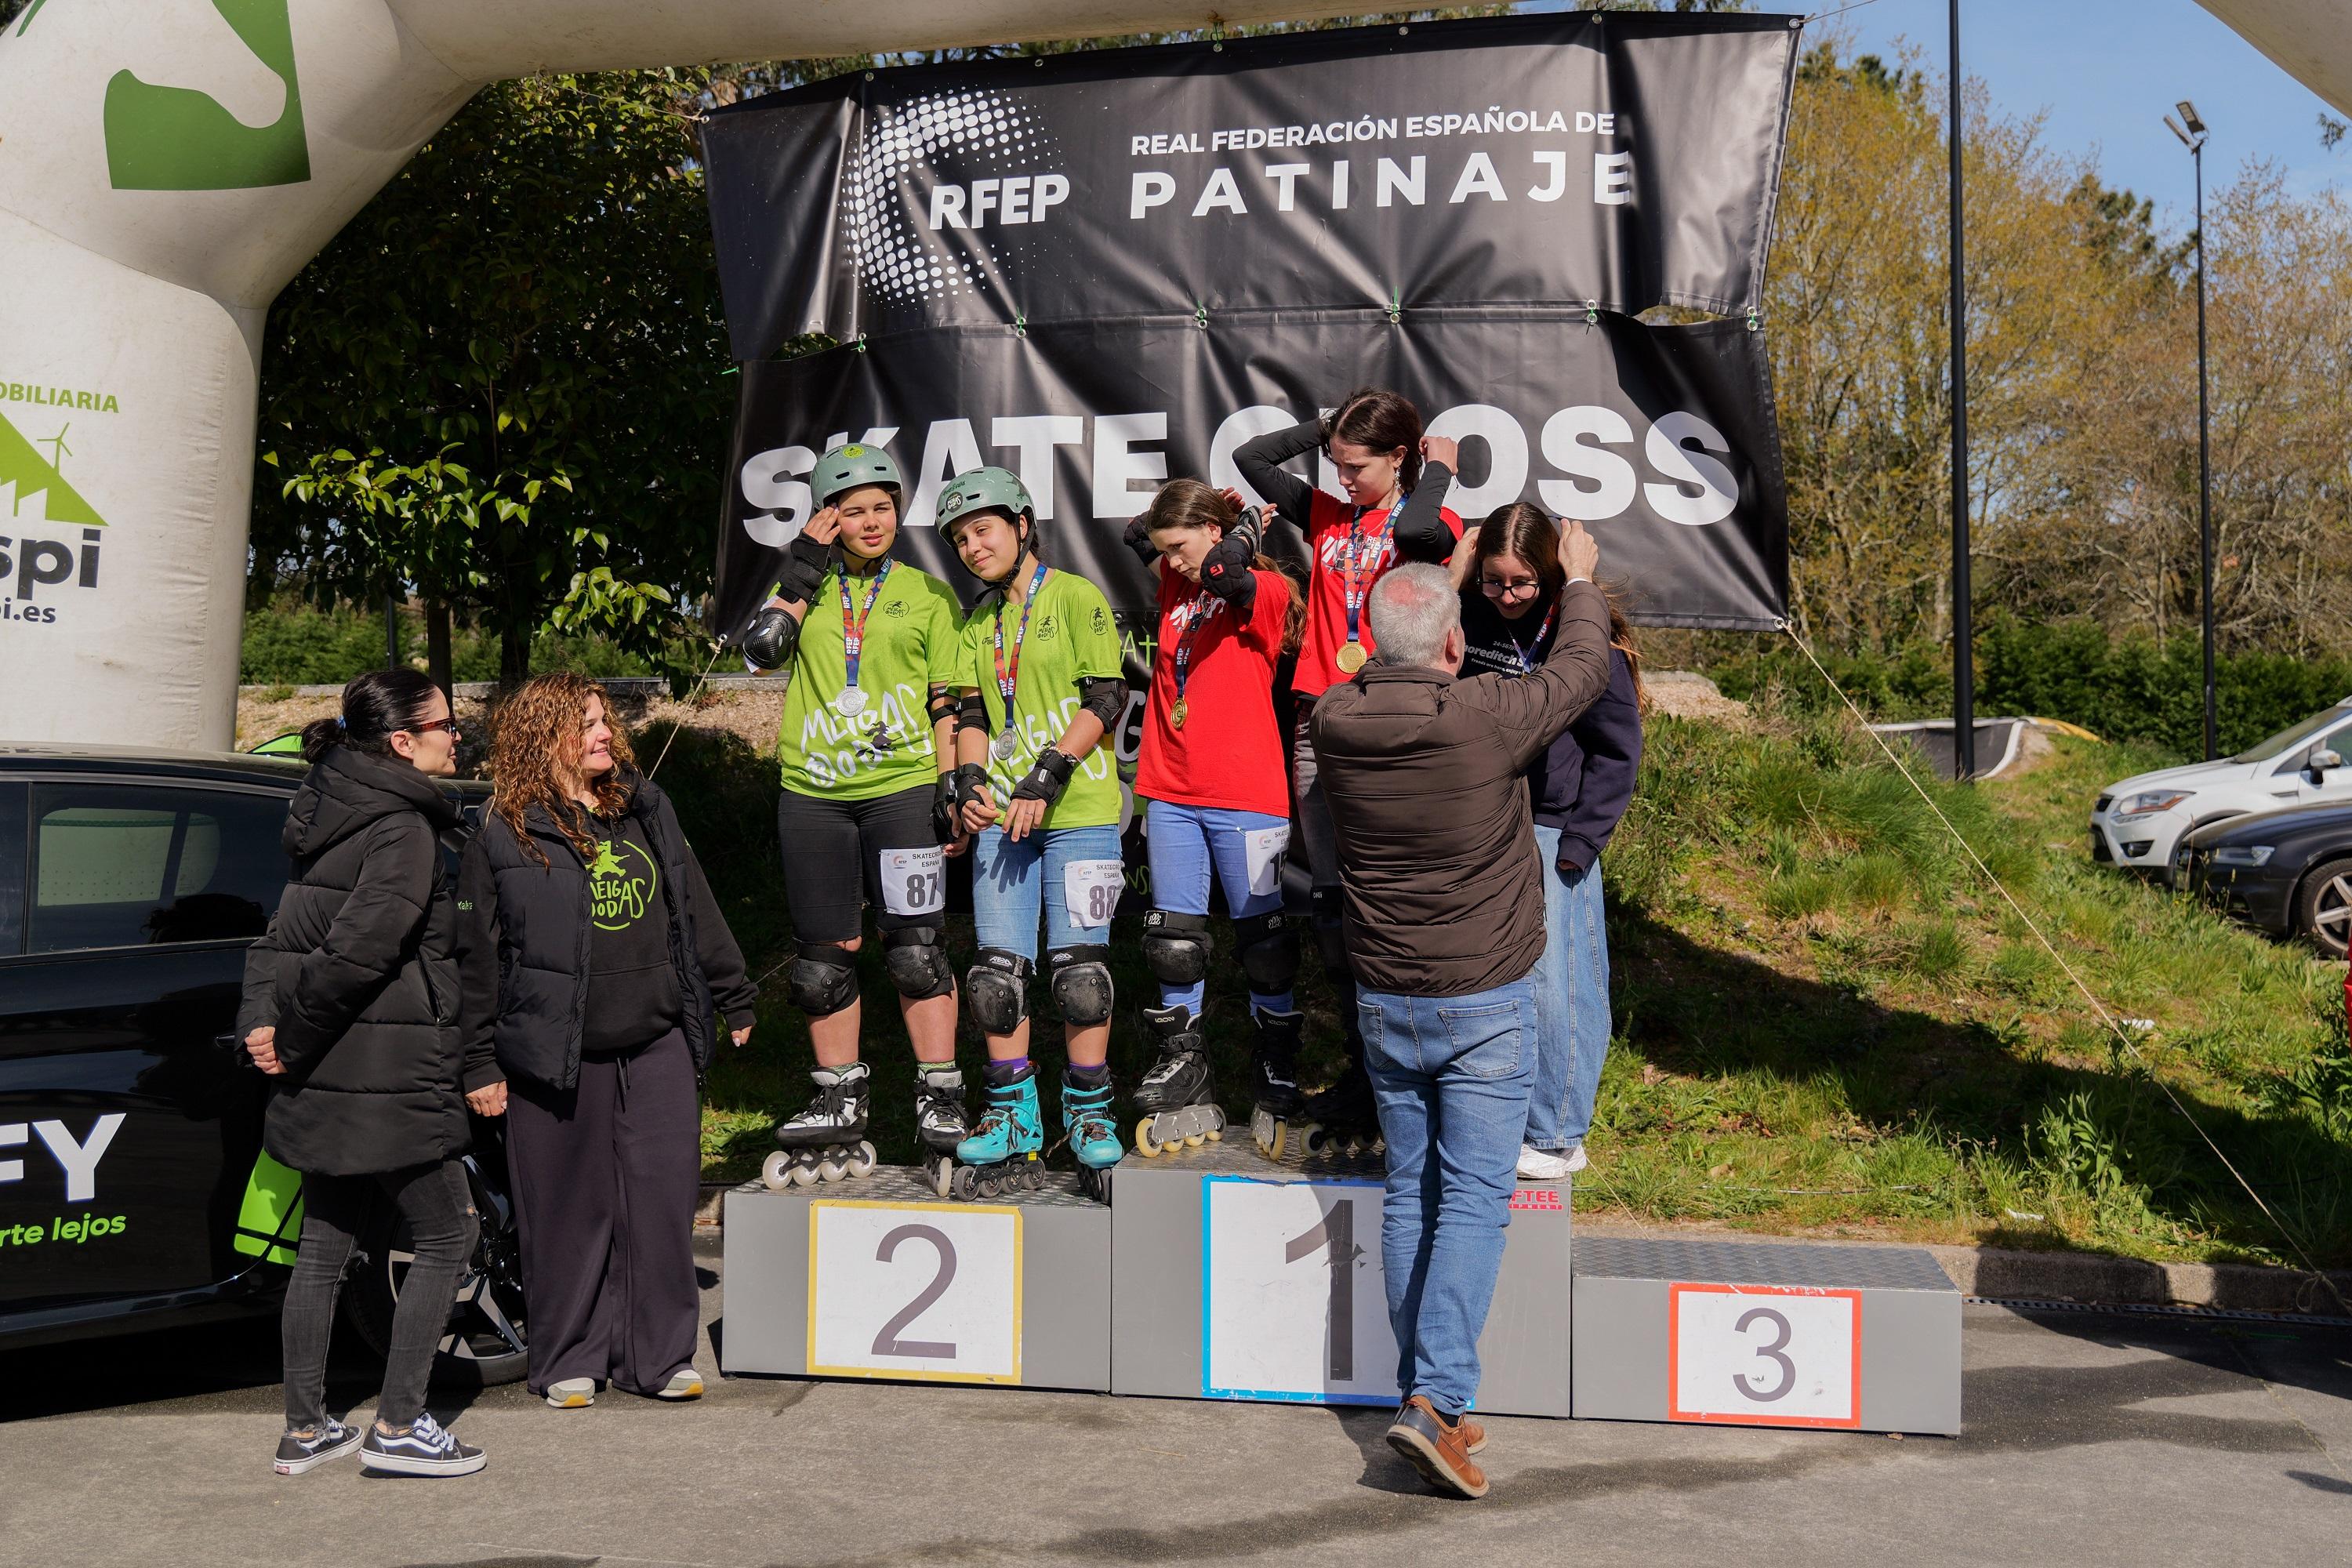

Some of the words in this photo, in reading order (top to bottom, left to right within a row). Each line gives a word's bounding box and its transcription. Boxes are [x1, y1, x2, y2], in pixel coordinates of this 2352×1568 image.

[1131, 133, 1204, 155] REAL
[1212, 114, 1399, 151] FEDERACIÓN
[1406, 106, 1568, 137] ESPAÑOLA
[1576, 111, 1614, 135] DE
[929, 174, 1070, 230] RFEP
[1130, 151, 1630, 220] PATINAJE
[1209, 404, 1739, 525] COSS
[1392, 503, 1403, 517] RFEP
[843, 596, 851, 609] RFEP
[864, 595, 874, 609] RFEP
[1029, 579, 1040, 594] RFEP
[1355, 590, 1365, 609] RFEP
[0, 597, 56, 623] i.es
[1016, 626, 1025, 643] RFEP
[906, 873, 938, 908] 87
[1089, 885, 1116, 920] 88
[52, 1213, 126, 1243] lejos
[870, 1223, 958, 1359] 2
[1285, 1199, 1353, 1381] 1
[1732, 1307, 1796, 1403] 3
